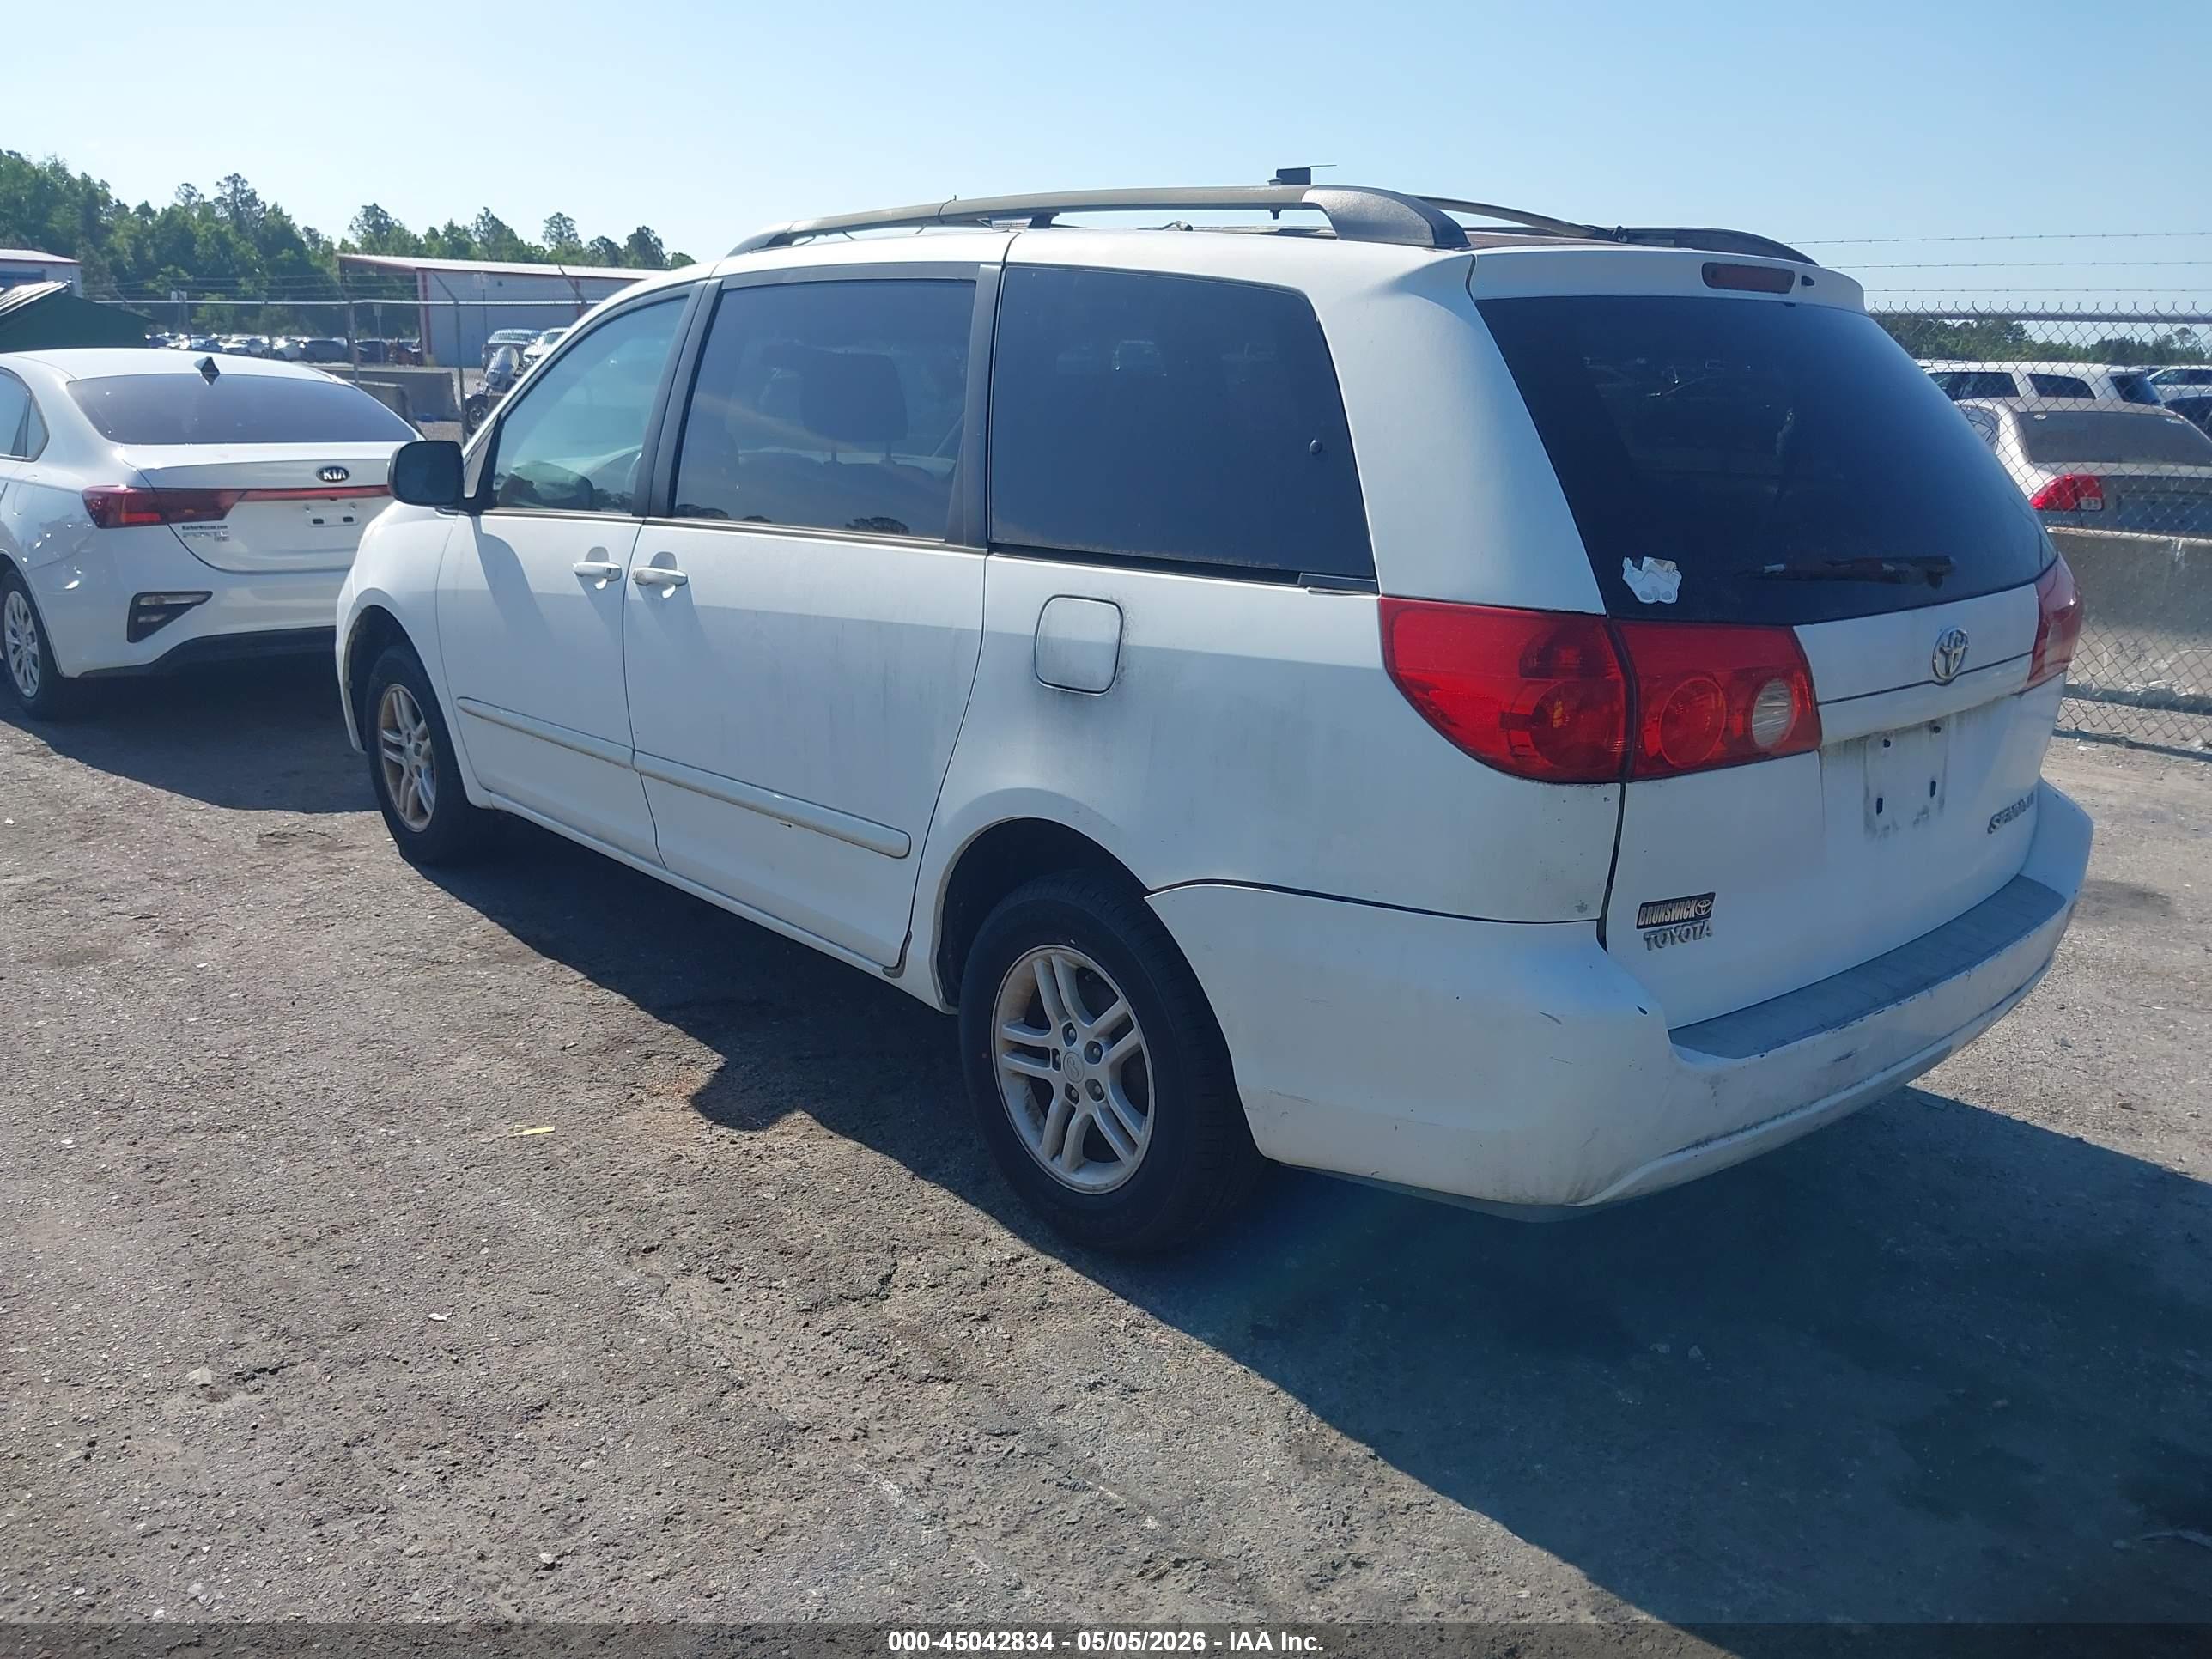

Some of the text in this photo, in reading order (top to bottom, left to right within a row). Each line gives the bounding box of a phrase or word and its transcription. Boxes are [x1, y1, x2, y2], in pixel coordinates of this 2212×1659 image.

[323, 469, 347, 480] KIA
[1638, 901, 1697, 925] BRUNSWICK
[1644, 921, 1713, 951] TOYOTA
